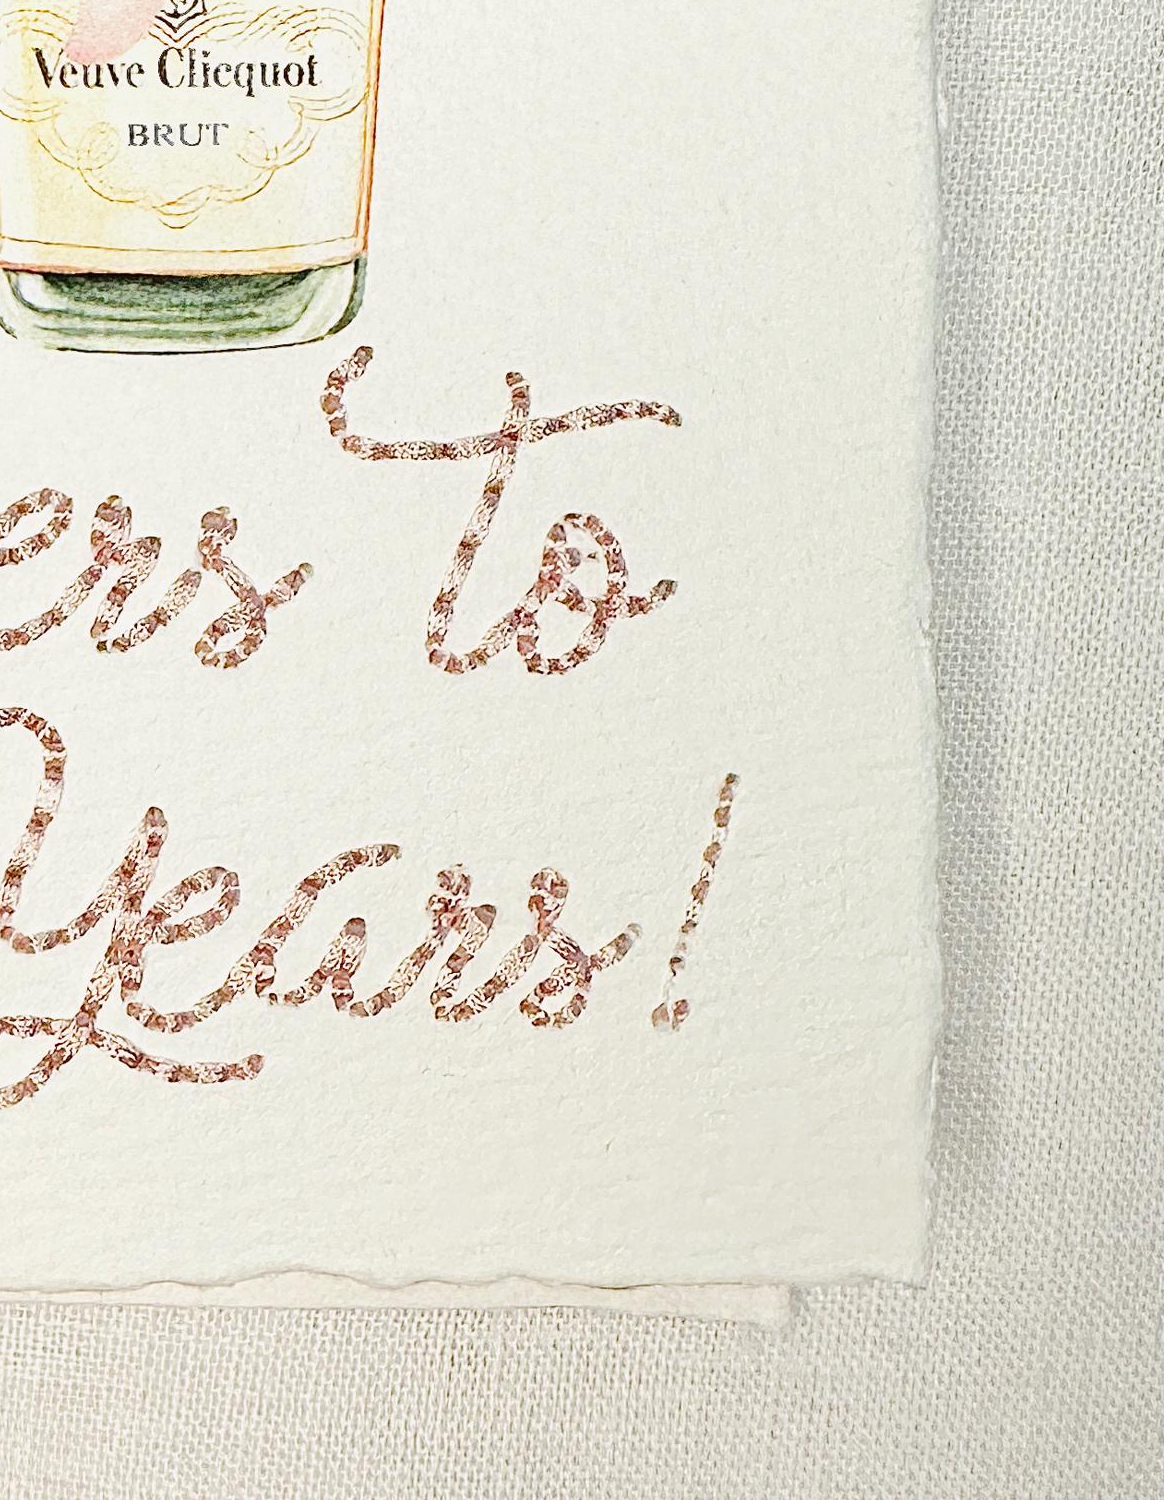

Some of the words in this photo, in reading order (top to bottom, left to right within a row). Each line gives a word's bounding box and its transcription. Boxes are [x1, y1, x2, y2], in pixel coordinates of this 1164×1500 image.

[34, 46, 146, 89] Veuve
[156, 46, 318, 98] Clicquot
[126, 122, 230, 148] BRUT
